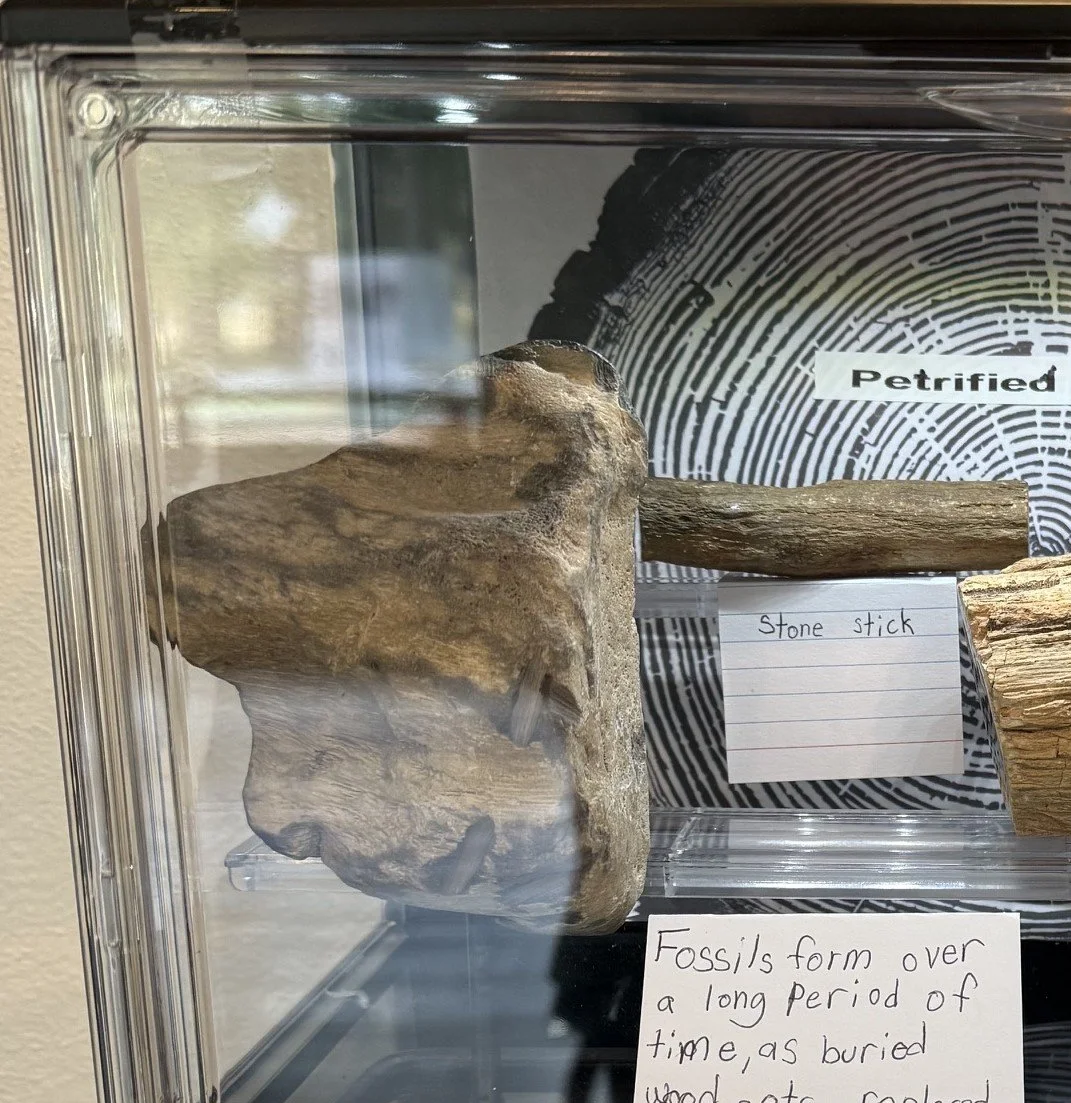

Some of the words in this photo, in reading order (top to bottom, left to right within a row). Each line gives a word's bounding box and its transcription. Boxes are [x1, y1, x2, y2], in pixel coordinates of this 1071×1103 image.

[851, 364, 1057, 392] Petrified
[758, 611, 824, 639] Stone
[853, 607, 915, 636] stick
[654, 927, 774, 975] Fossils
[786, 934, 872, 972] form
[902, 938, 986, 972] over
[657, 995, 674, 1014] a
[705, 983, 767, 1028] long
[926, 972, 979, 1013] of
[821, 1021, 927, 1066] buried
